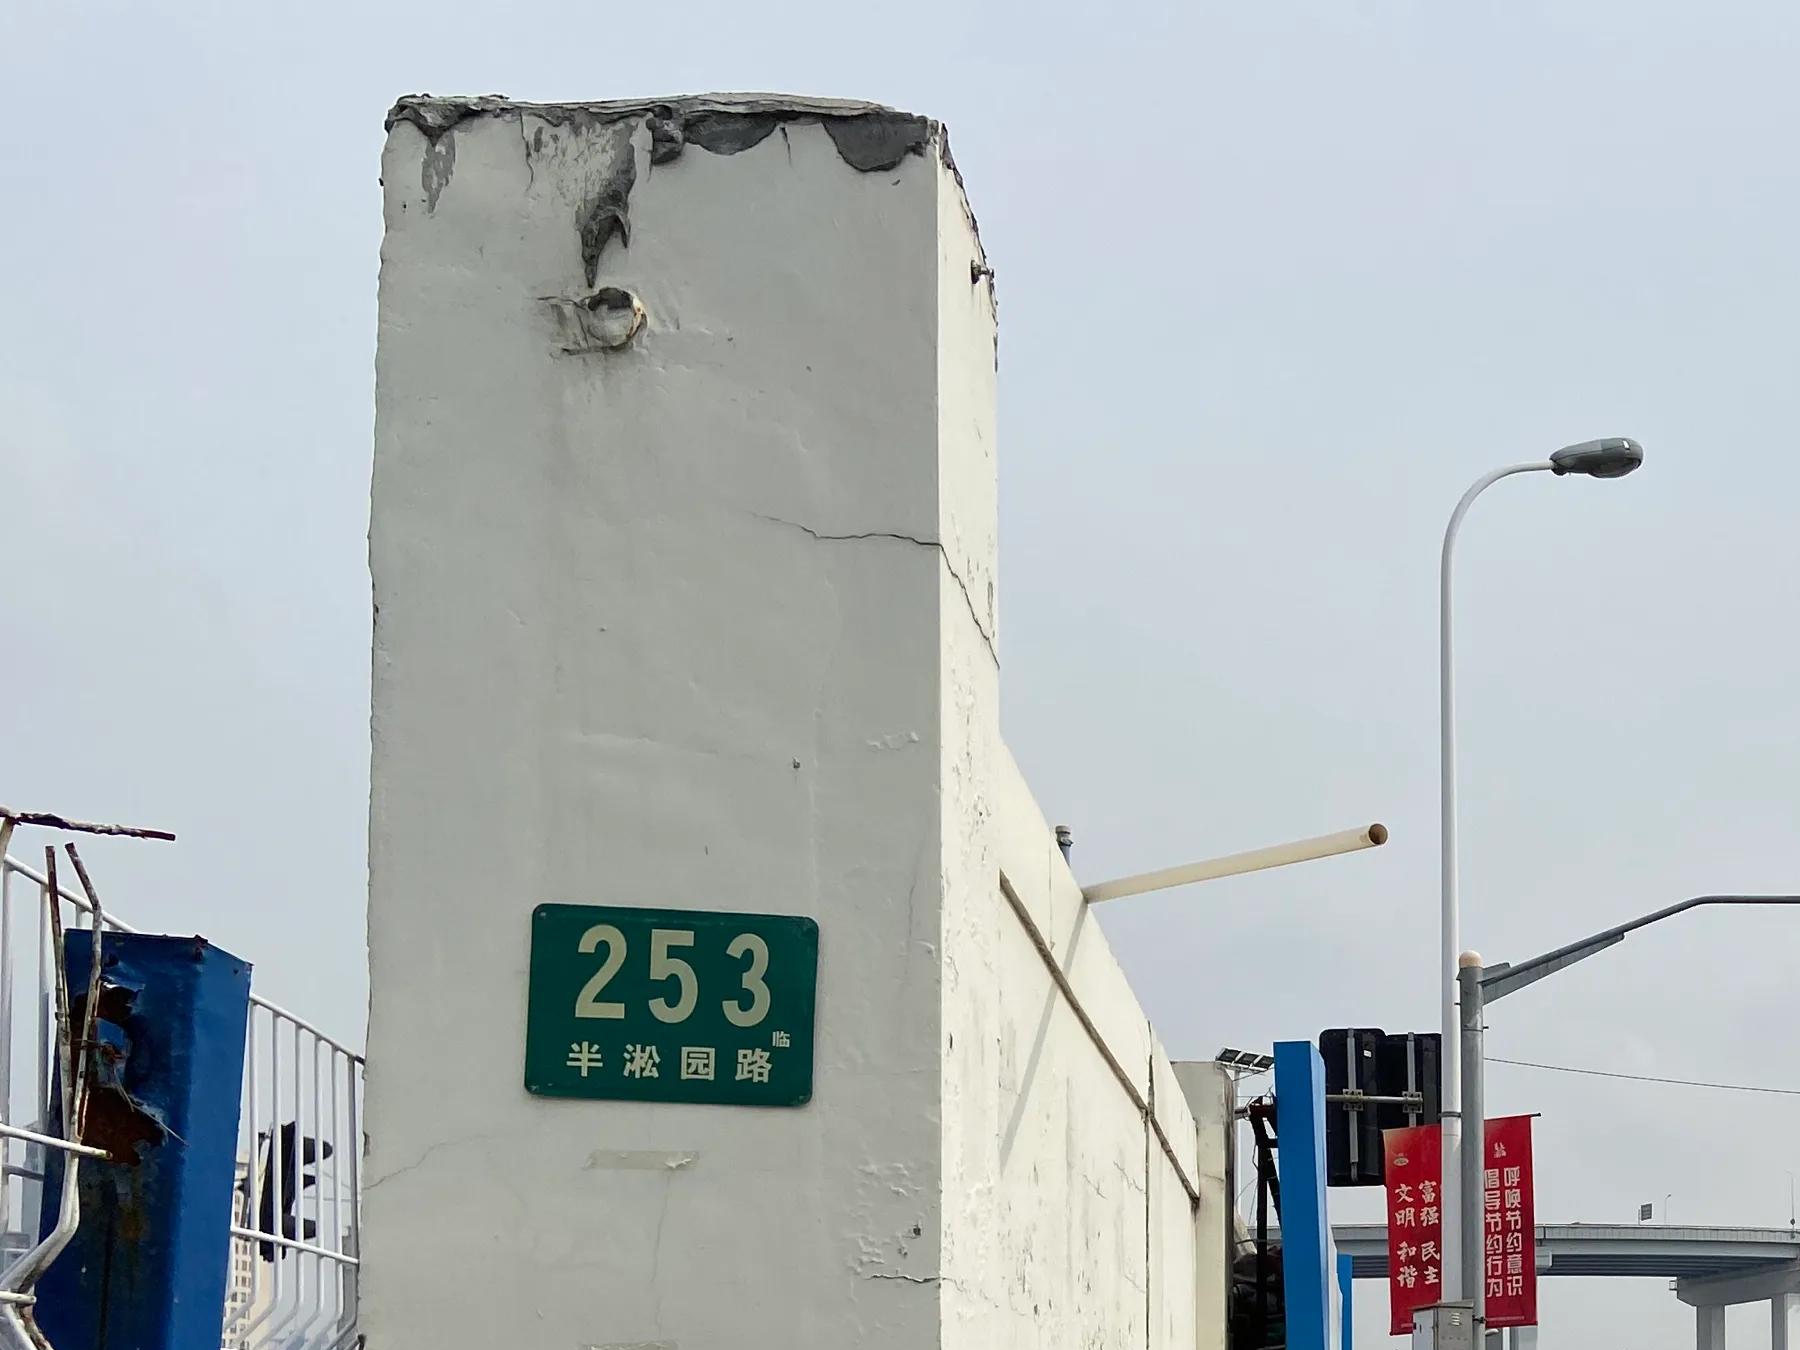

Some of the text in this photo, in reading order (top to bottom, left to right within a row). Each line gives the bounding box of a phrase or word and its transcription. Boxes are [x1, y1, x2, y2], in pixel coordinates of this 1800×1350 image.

[575, 924, 771, 1028] 253
[566, 1041, 773, 1083] 半淞园路
[772, 1031, 791, 1049] 临
[1395, 1184, 1418, 1288] 文明 和谐
[1418, 1180, 1440, 1284] 富强 民主
[1484, 1168, 1503, 1297] 倡导节约行为
[1504, 1166, 1522, 1296] 呼唤节约意识
